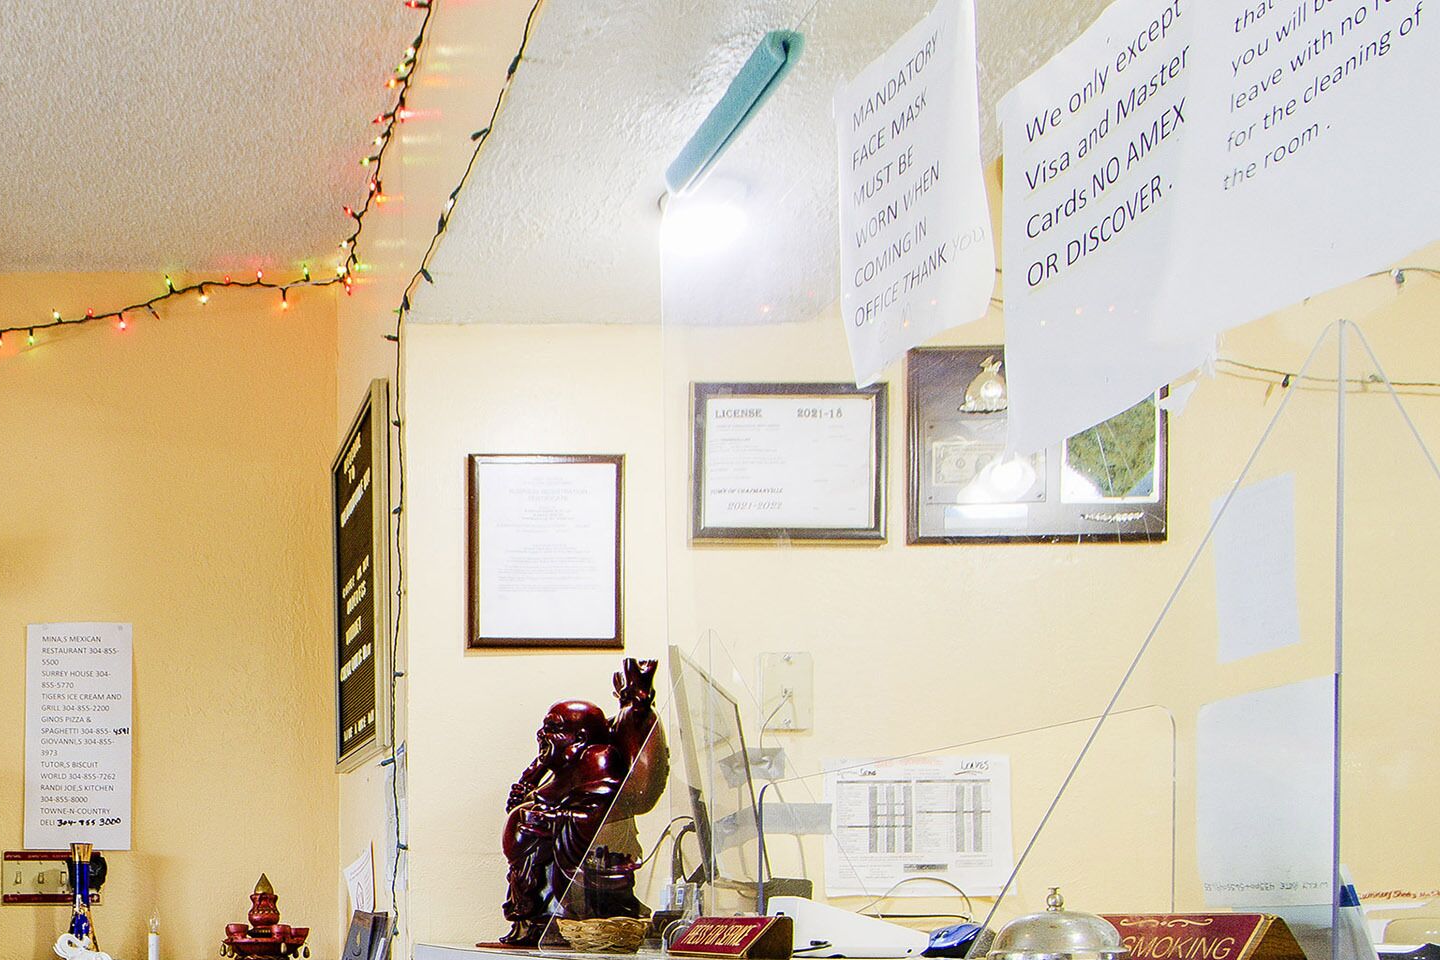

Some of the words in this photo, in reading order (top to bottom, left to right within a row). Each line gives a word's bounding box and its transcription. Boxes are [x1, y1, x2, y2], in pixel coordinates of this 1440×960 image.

[852, 30, 938, 132] MANDATORY
[1025, 106, 1061, 143] We
[1069, 64, 1109, 113] only
[1116, 0, 1183, 73] except
[1227, 123, 1256, 152] for
[1263, 99, 1297, 130] the
[1303, 30, 1392, 104] cleaning
[1400, 1, 1423, 36] of
[1231, 38, 1269, 78] you
[1275, 2, 1306, 43] will
[1231, 68, 1283, 113] leave
[1290, 29, 1333, 72] with
[1341, 6, 1366, 36] no
[853, 127, 886, 171] FACE
[891, 87, 927, 140] MASK
[1025, 151, 1070, 191] Visa
[1077, 108, 1109, 158] and
[1116, 45, 1190, 126] Master
[1224, 162, 1257, 190] the
[1264, 123, 1319, 168] room
[853, 162, 893, 208] MUST
[898, 145, 913, 176] BE
[855, 200, 898, 249] WORN
[903, 160, 940, 212] WHEN
[1027, 188, 1087, 239] Cards
[1092, 156, 1120, 198] NO
[1126, 96, 1186, 171] AMEX
[854, 231, 910, 288] COMING
[915, 216, 928, 245] IN
[1027, 253, 1058, 287] OR
[1067, 175, 1162, 267] DISCOVER
[855, 281, 899, 327] OFFICE
[903, 243, 947, 294] THANK
[715, 408, 763, 418] LICENSE
[715, 924, 757, 946] SERVICE
[1122, 936, 1235, 960] SMOKING
